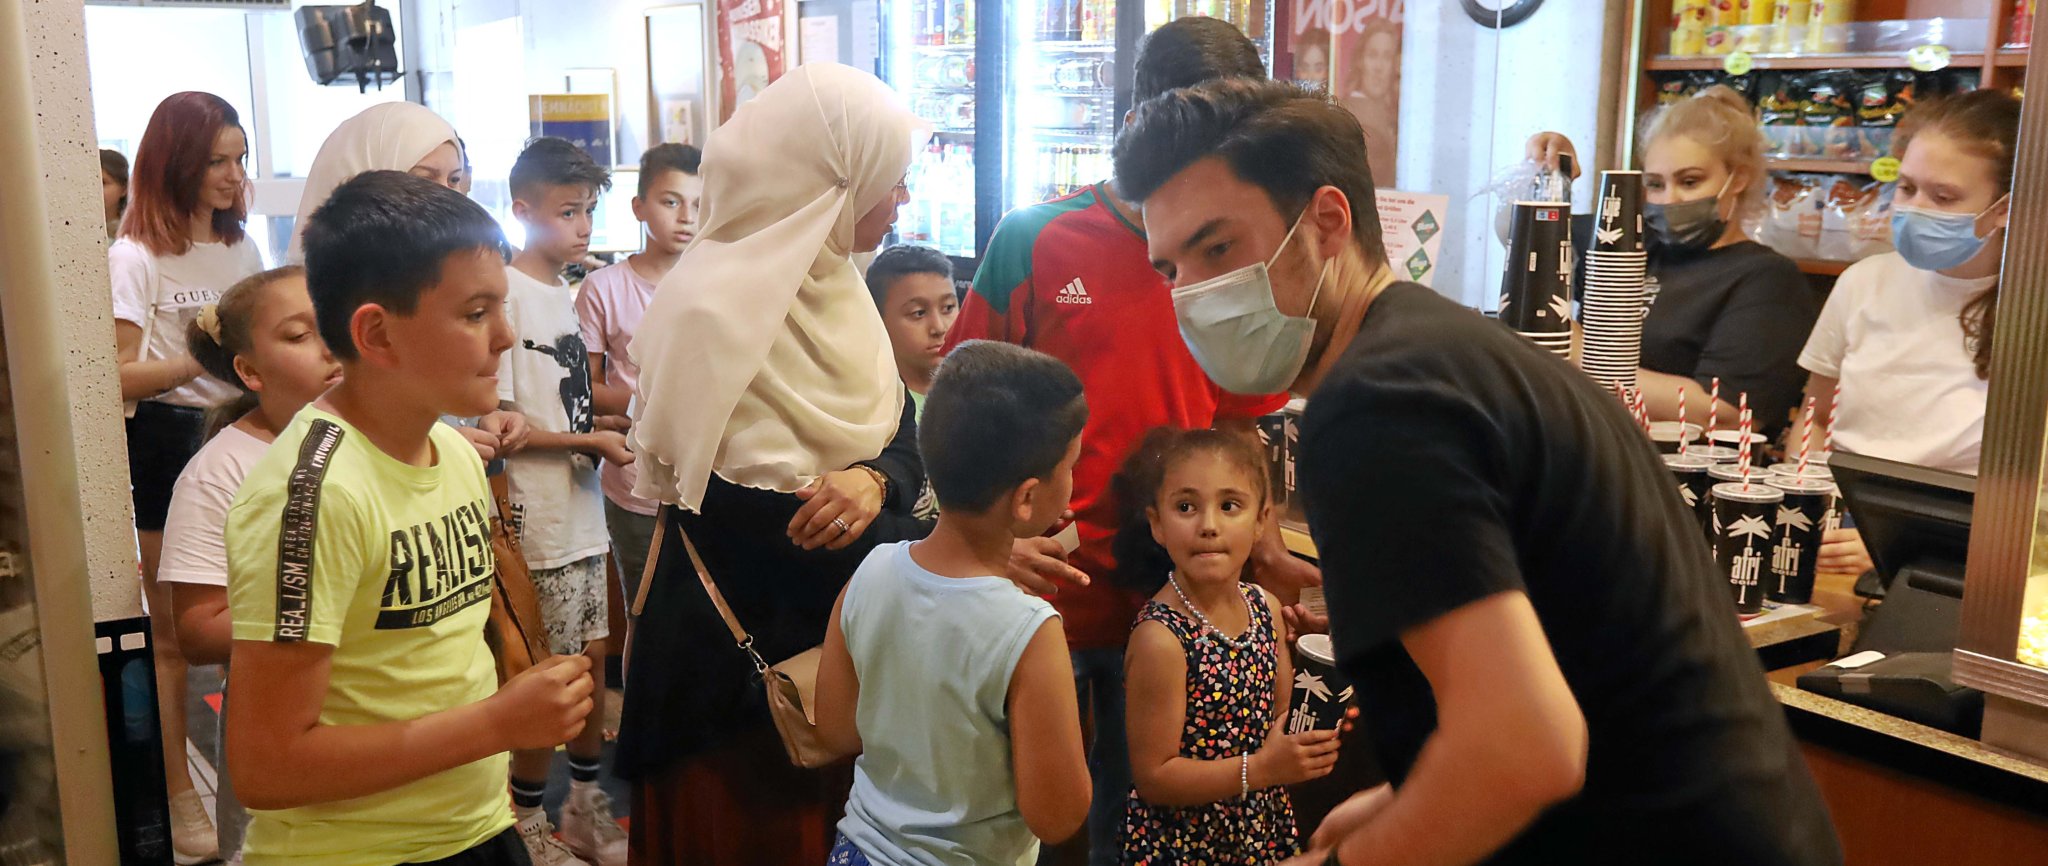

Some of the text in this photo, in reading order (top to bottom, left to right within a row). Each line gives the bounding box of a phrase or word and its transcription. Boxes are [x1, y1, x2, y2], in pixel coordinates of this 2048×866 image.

[174, 290, 223, 304] GUES
[1056, 294, 1092, 304] adidas
[1731, 547, 1762, 580] afri
[1772, 537, 1801, 572] afri
[412, 608, 433, 625] LOS
[1290, 702, 1317, 735] afri
